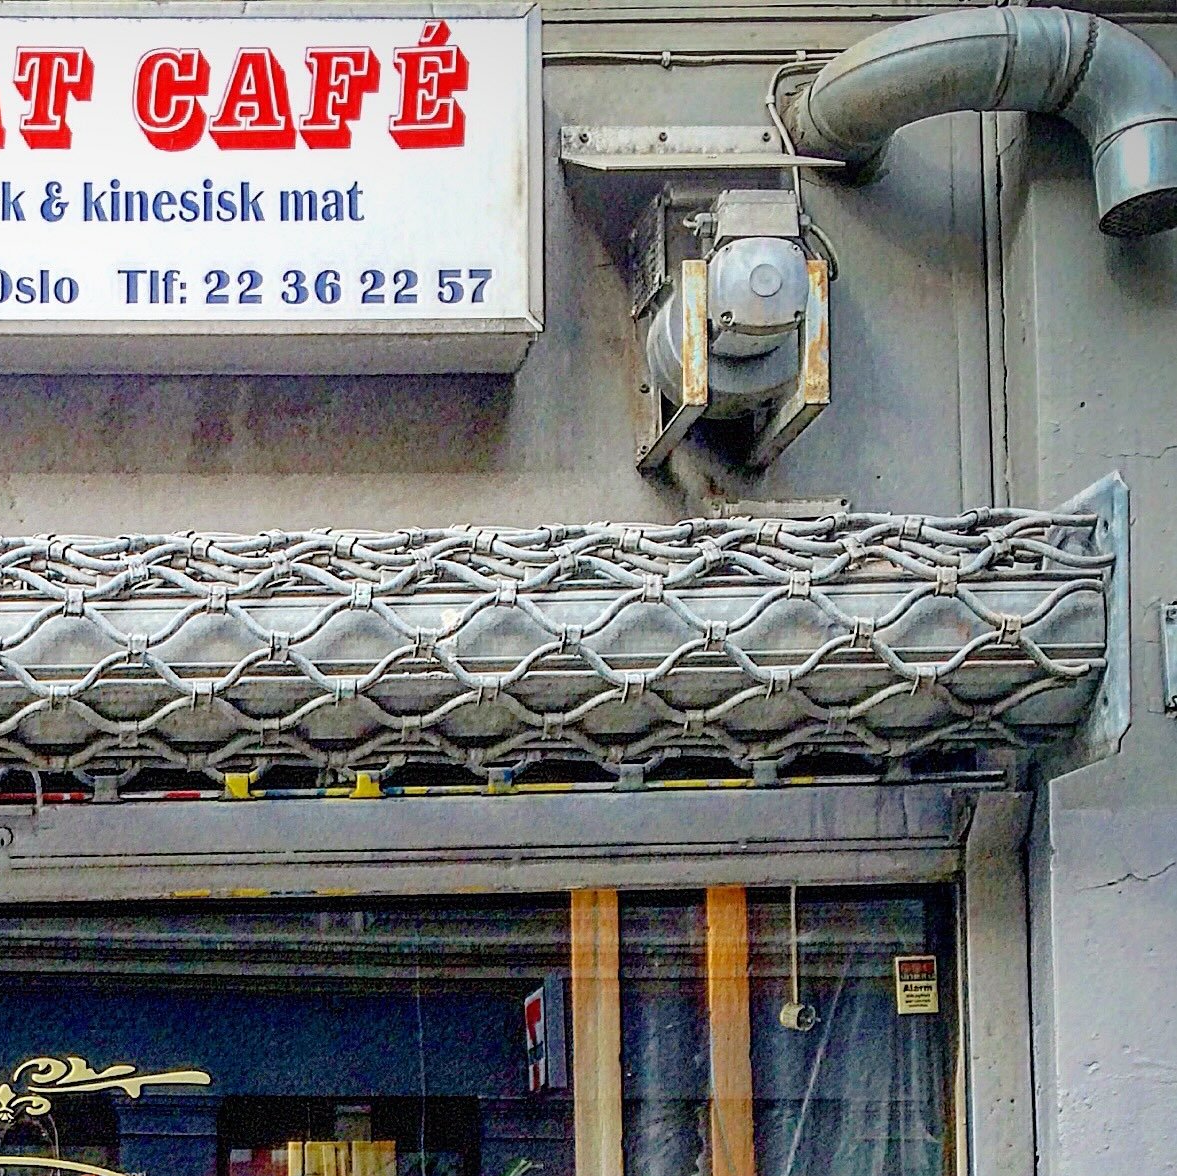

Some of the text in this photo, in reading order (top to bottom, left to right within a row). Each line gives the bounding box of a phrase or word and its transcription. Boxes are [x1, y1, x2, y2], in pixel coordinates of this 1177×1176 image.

[134, 20, 471, 151] CAFÉ
[40, 182, 68, 222] &
[83, 178, 264, 222] kinesisk
[279, 179, 366, 222] mat
[117, 267, 187, 305] Tlf:
[204, 269, 263, 305] 22
[281, 269, 342, 305] 36
[360, 269, 418, 305] 22
[438, 269, 494, 304] 57
